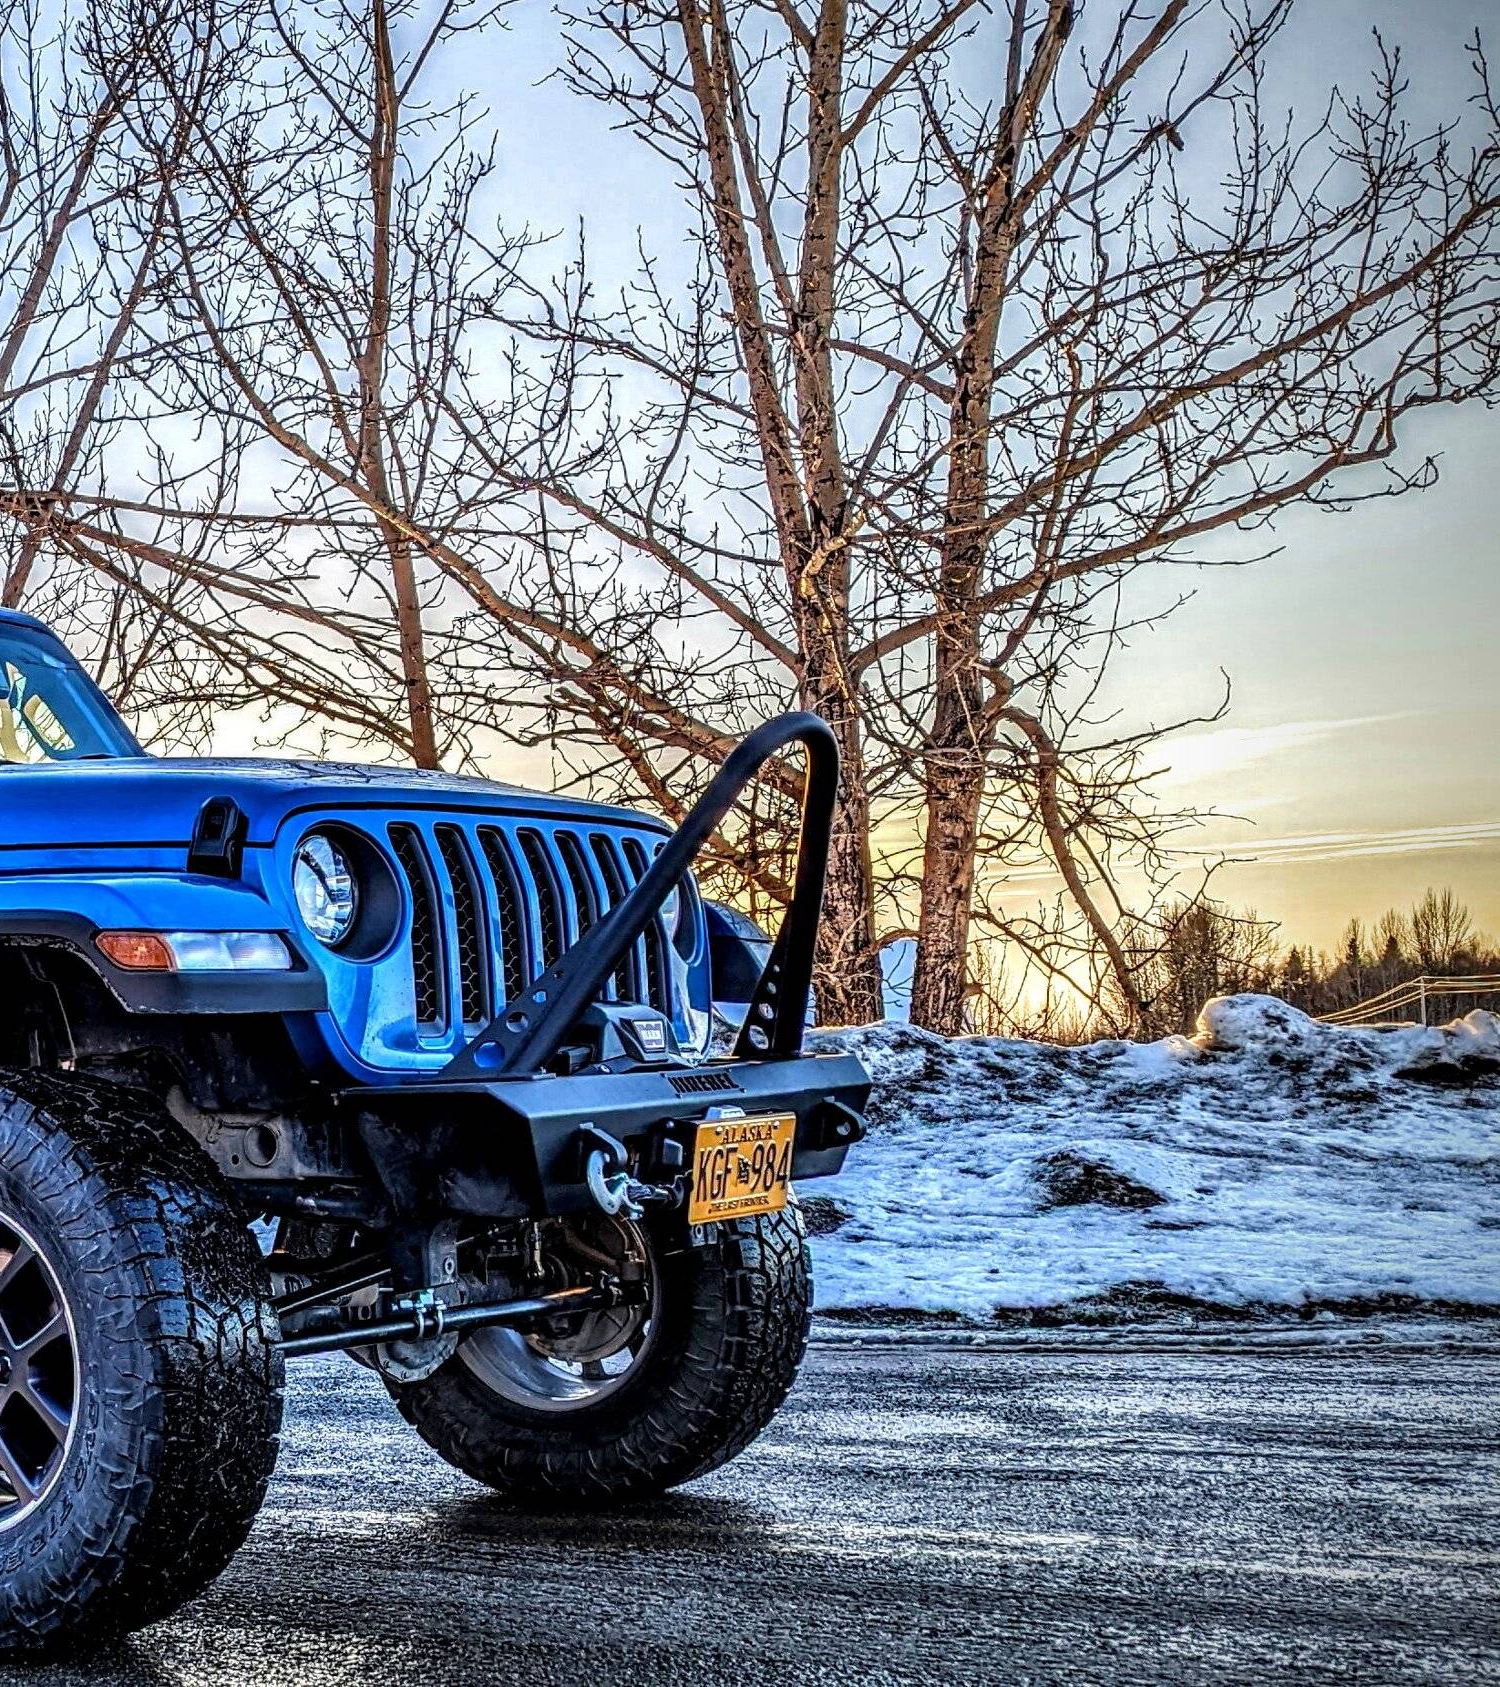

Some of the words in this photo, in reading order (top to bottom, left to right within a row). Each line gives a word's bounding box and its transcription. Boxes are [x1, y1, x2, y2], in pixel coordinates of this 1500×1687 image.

[721, 1124, 773, 1144] ALASKA
[696, 1144, 740, 1202] KGF
[750, 1138, 792, 1193] 984
